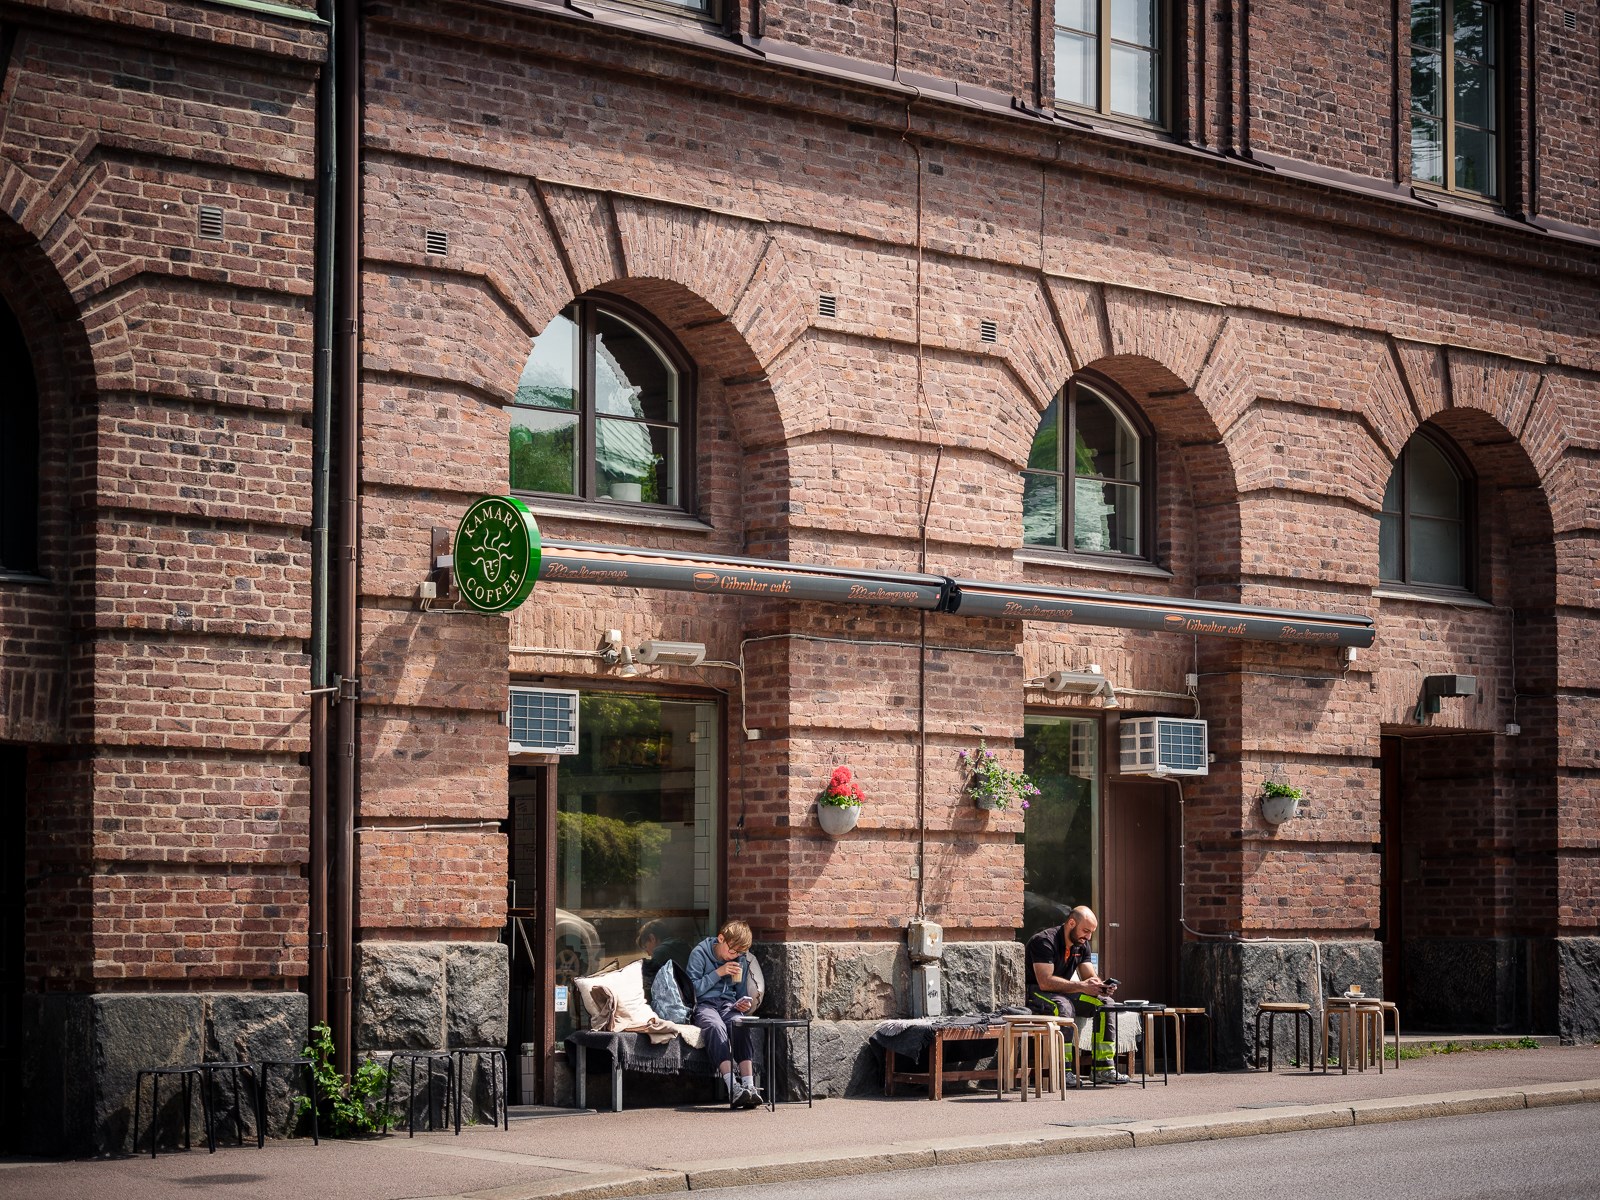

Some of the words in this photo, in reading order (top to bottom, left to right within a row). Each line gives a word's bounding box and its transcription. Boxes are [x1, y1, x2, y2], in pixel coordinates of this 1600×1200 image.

[464, 506, 518, 539] KAMARI
[466, 569, 520, 603] COFFEE
[720, 575, 768, 592] Gibraltar
[769, 580, 792, 593] café
[1186, 618, 1227, 633] Gibraltar
[1227, 623, 1247, 635] café
[1415, 701, 1424, 726] 4
